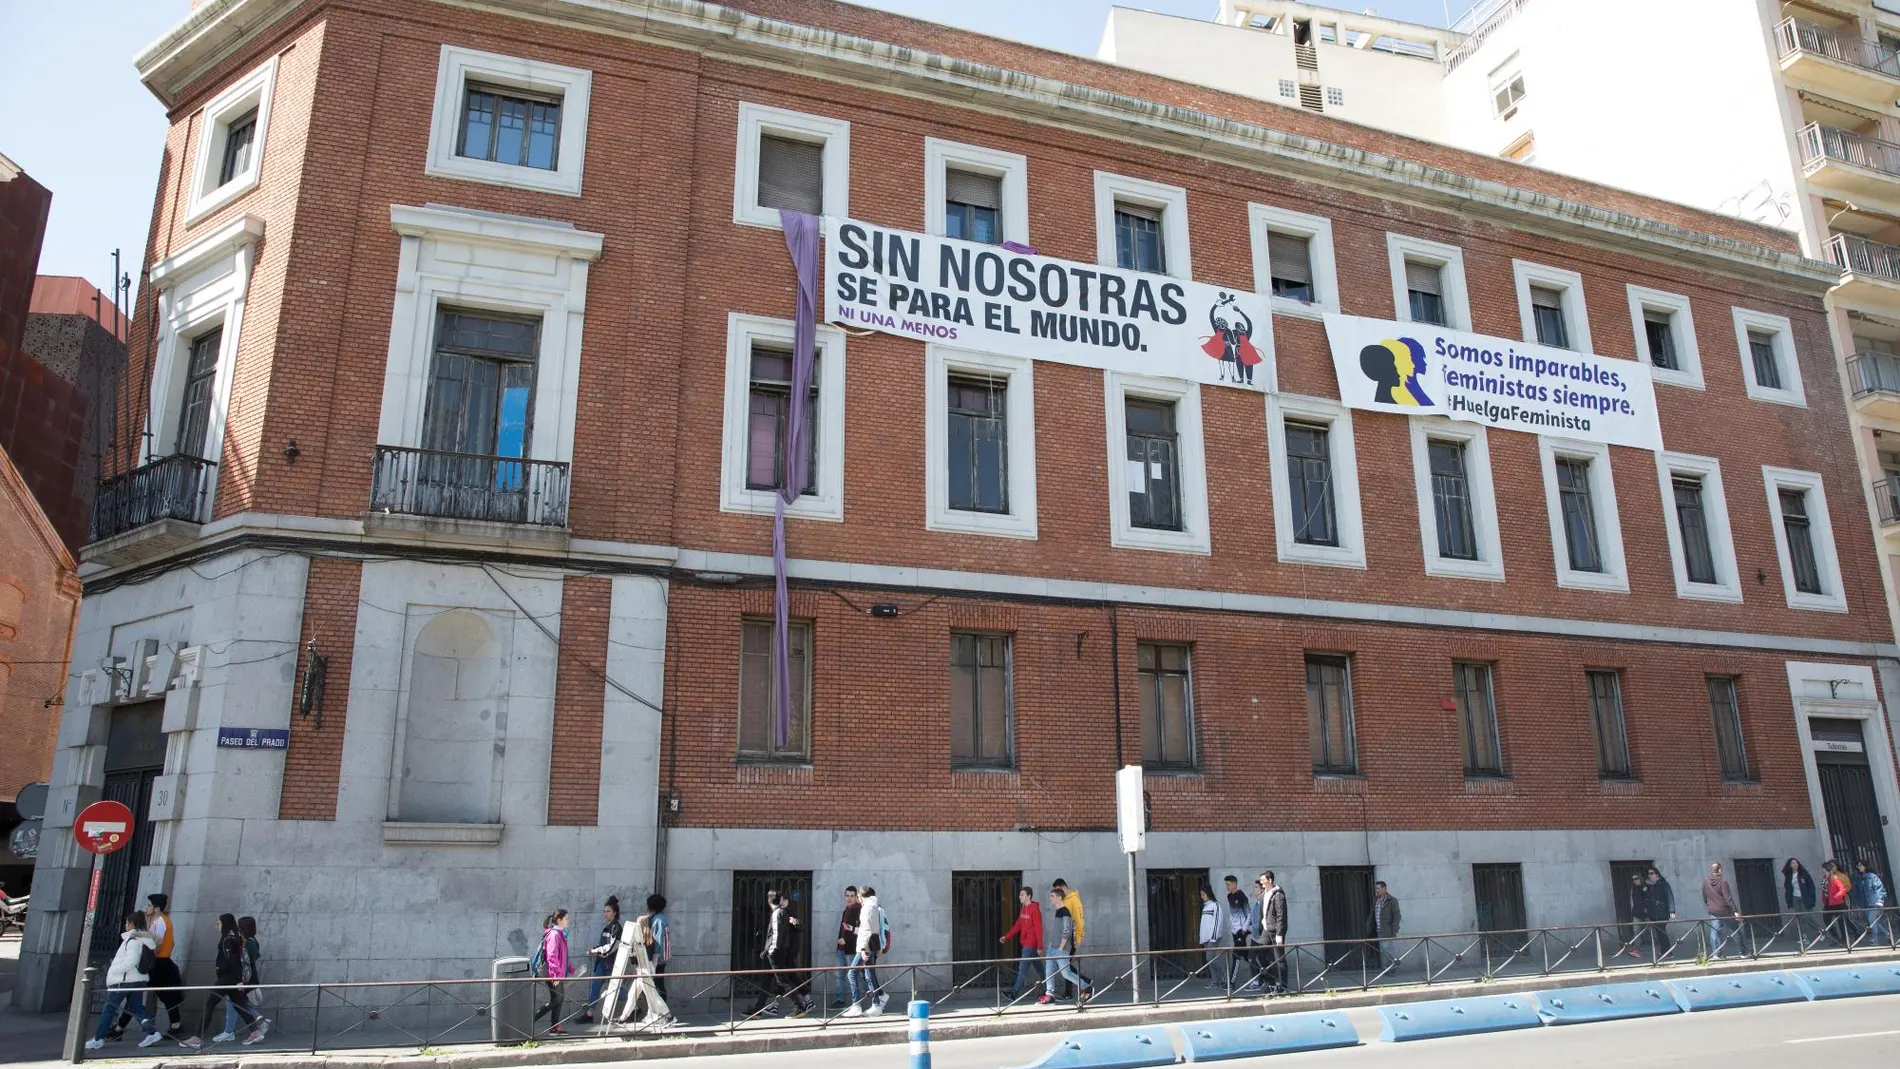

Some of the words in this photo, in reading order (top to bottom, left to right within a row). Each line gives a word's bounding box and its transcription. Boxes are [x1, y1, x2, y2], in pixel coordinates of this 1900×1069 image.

[838, 223, 921, 283] SIN
[939, 243, 1187, 326] NOSOTRAS
[837, 272, 878, 307] SE
[888, 282, 975, 327] PARA
[984, 301, 1021, 336] EL
[1030, 309, 1149, 353] MUNDO.
[838, 304, 855, 320] NI
[860, 310, 896, 329] UNA
[901, 319, 958, 340] MENOS
[1435, 336, 1504, 368] Somos
[1509, 348, 1627, 393] imparables,
[1552, 388, 1636, 417] siempre.
[220, 736, 243, 746] PASEO
[245, 738, 259, 746] DEL
[261, 738, 285, 747] PRADO
[157, 790, 168, 806] 30
